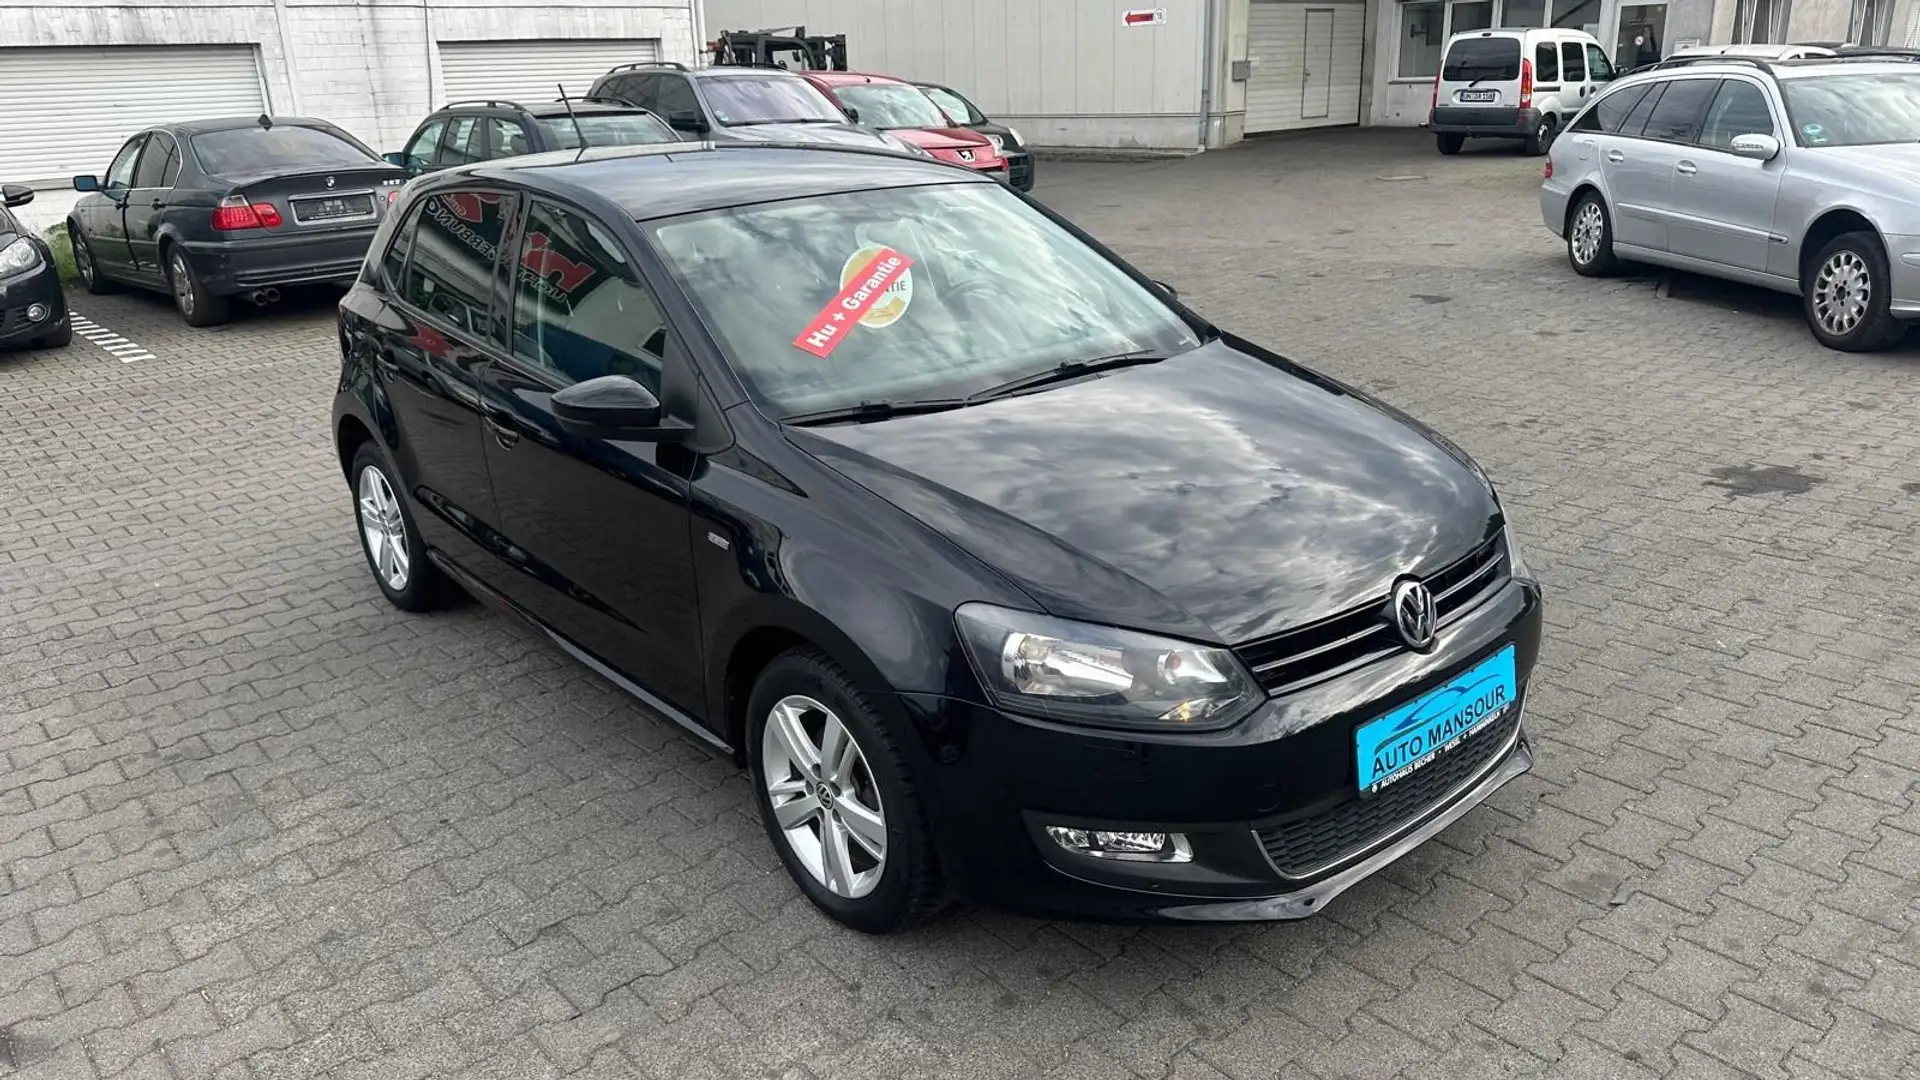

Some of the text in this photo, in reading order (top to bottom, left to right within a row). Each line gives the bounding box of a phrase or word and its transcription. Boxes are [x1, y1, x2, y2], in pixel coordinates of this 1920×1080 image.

[806, 324, 838, 348] Hu
[842, 257, 901, 309] Garantie
[1371, 684, 1506, 779] AUTO MANSOUR
[1380, 764, 1413, 789] AUTOHAUS
